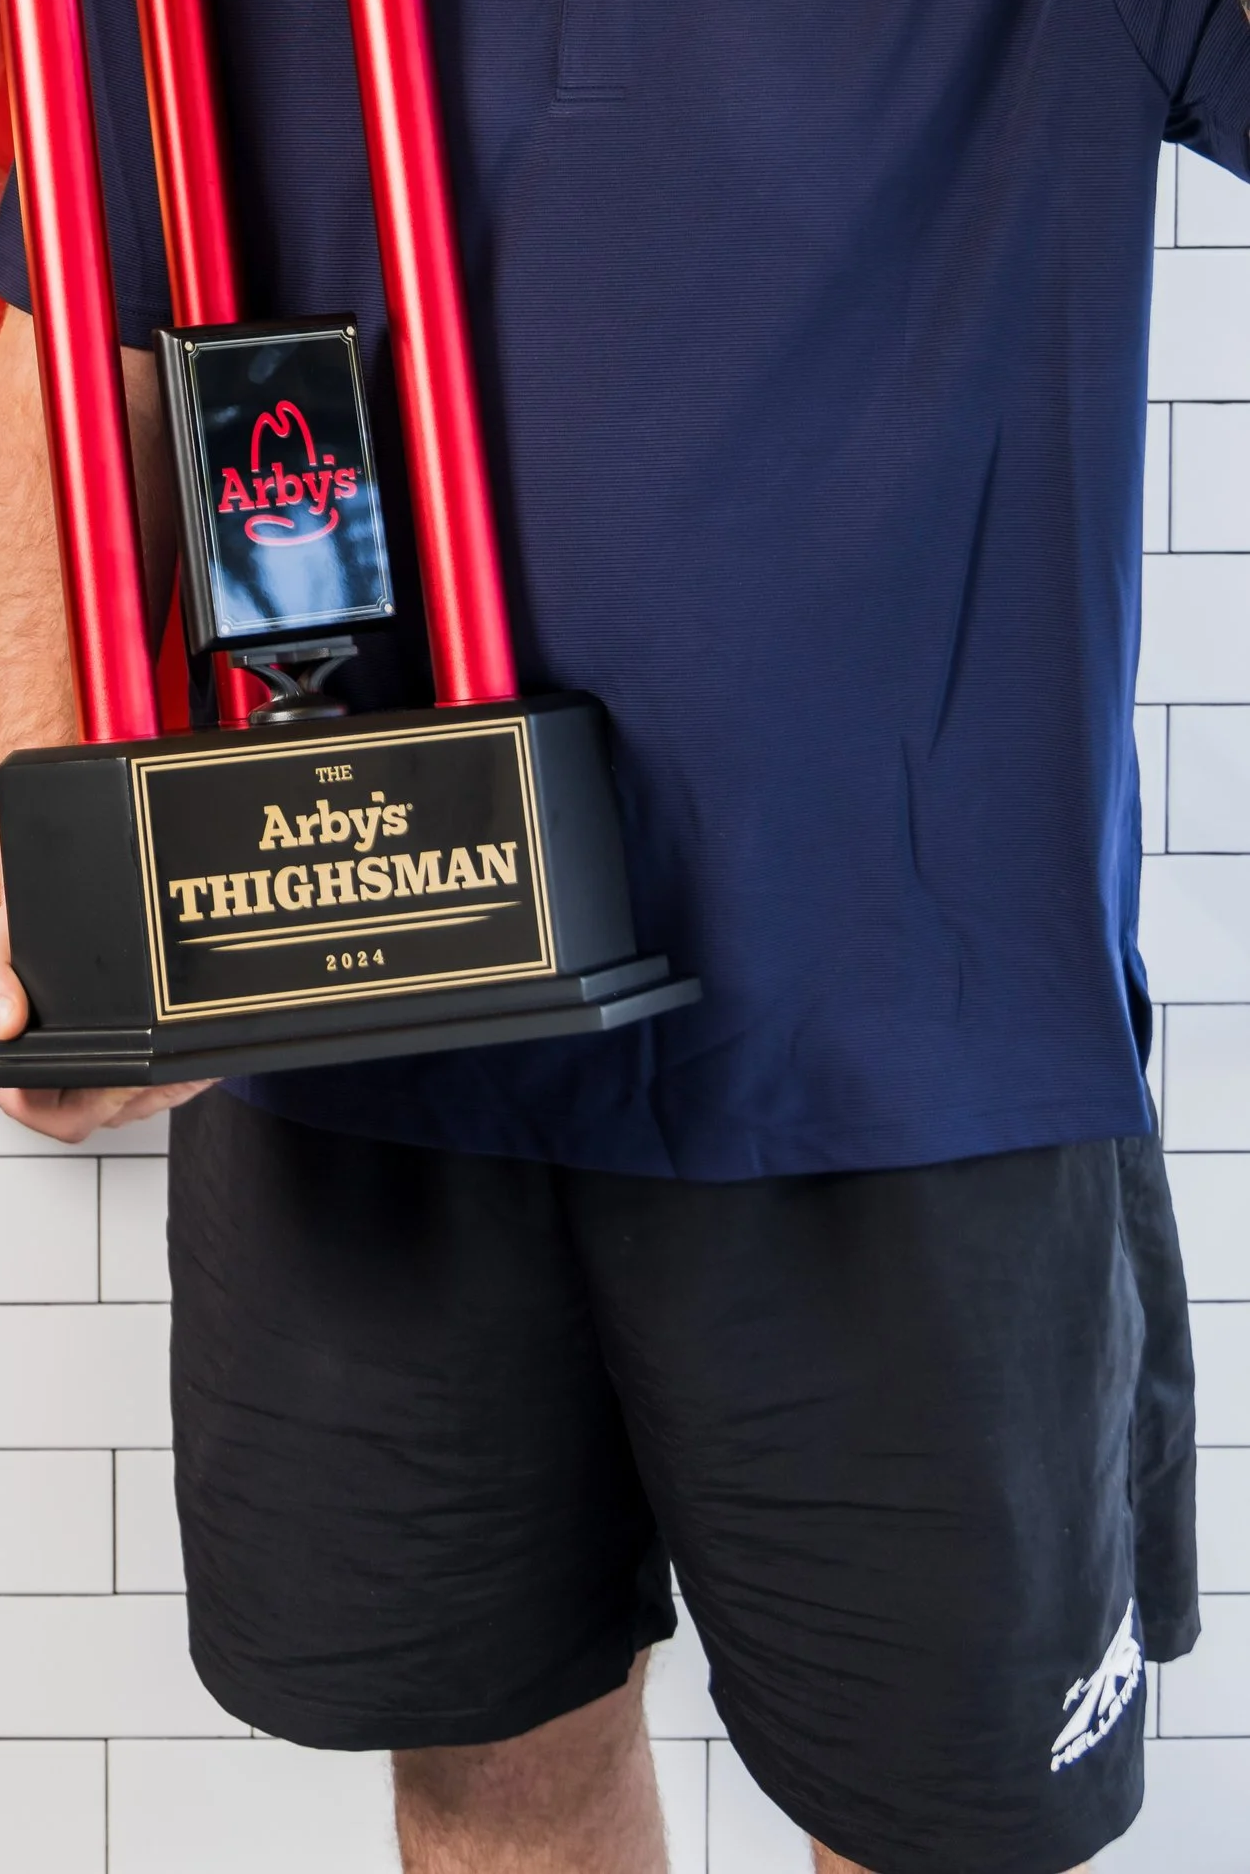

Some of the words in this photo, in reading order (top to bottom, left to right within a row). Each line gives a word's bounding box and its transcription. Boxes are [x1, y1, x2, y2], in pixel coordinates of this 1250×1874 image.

[218, 454, 358, 516] Arby's
[315, 764, 353, 783] THE
[258, 791, 409, 852] Arby's
[169, 841, 518, 923] THIGHSMAN
[325, 948, 385, 972] 2024
